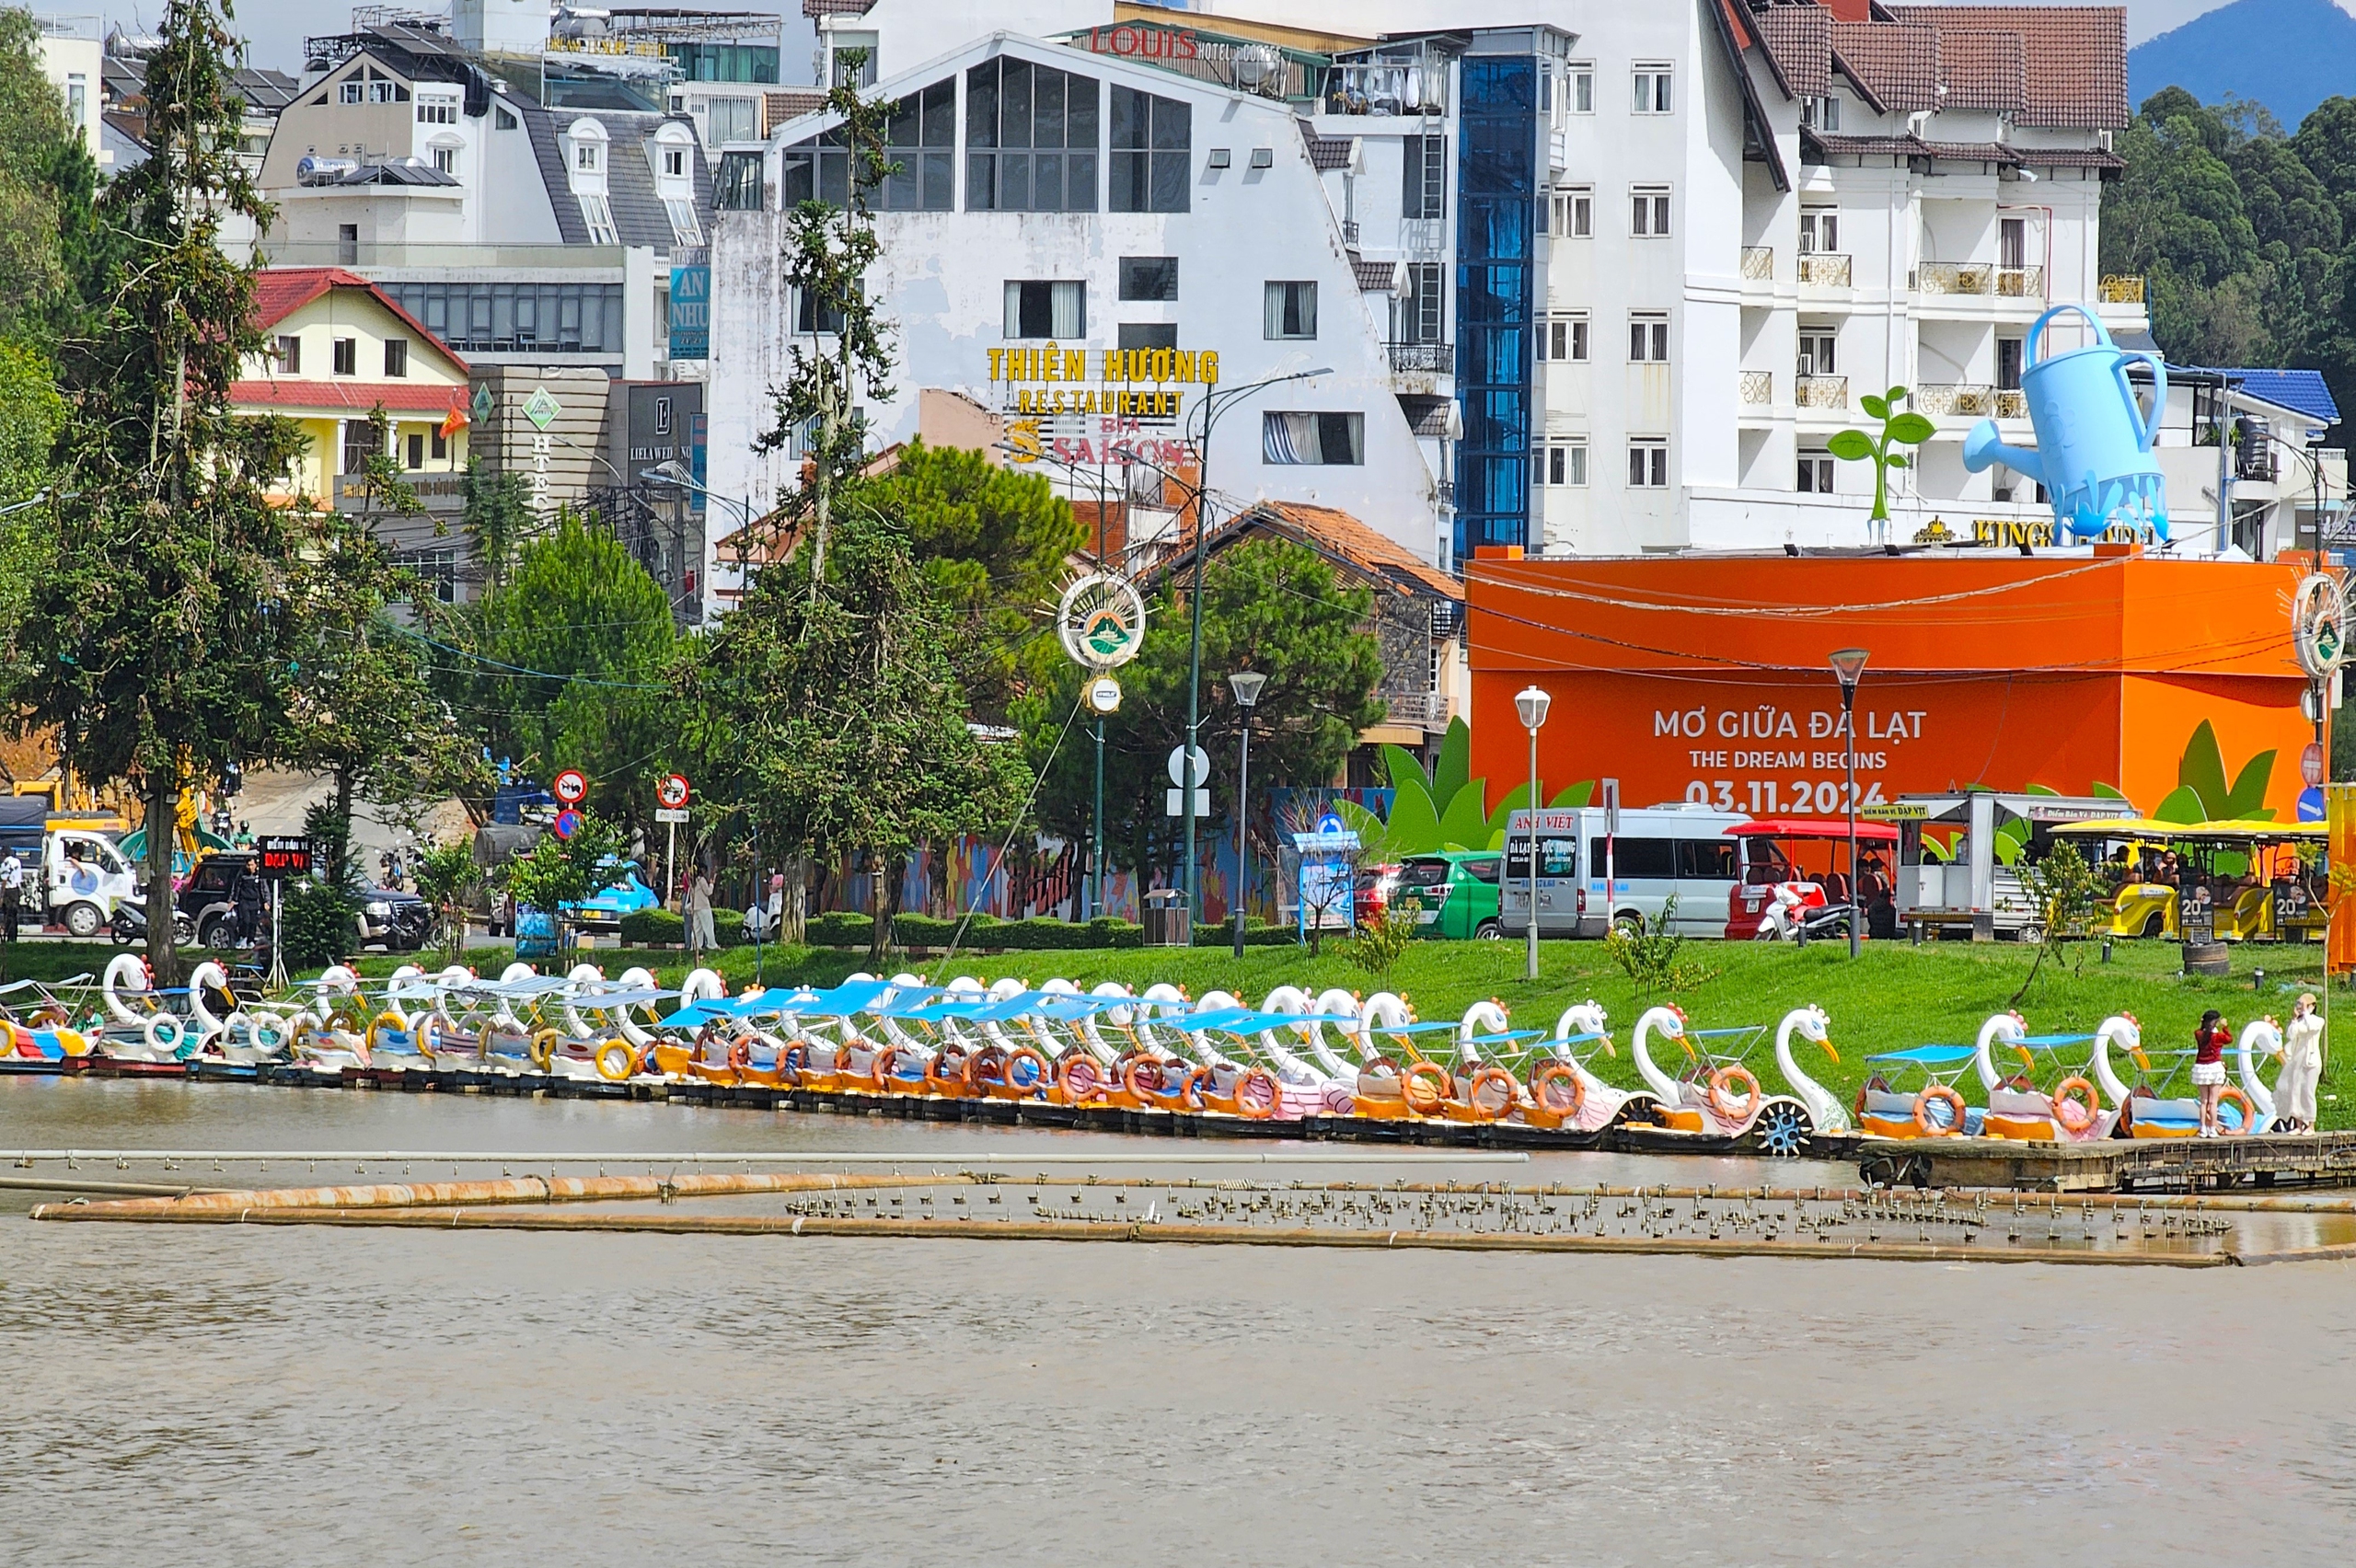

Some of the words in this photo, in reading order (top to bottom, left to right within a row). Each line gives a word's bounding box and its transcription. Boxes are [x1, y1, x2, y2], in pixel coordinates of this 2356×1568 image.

[1090, 26, 1196, 59] LOUIS
[1198, 41, 1230, 61] HOTEL
[678, 271, 705, 296] AN
[987, 341, 1086, 382] THIÊN
[1104, 345, 1219, 384] HƯƠNG
[1018, 389, 1184, 415] RESTAURANT
[1100, 417, 1141, 433] BIA
[653, 445, 691, 460] WEDNG
[1654, 705, 1706, 737] MƠ
[1717, 704, 1798, 738] GIỮA
[1807, 703, 1856, 739] ĐÀ
[1868, 711, 1927, 745] LẠT
[1689, 751, 1727, 767] THE
[1734, 751, 1805, 768] DREAM
[1685, 779, 1888, 814] 03.11.2024
[1546, 813, 1574, 832] VIỆT
[2182, 899, 2201, 916] 20
[2277, 898, 2296, 916] 20
